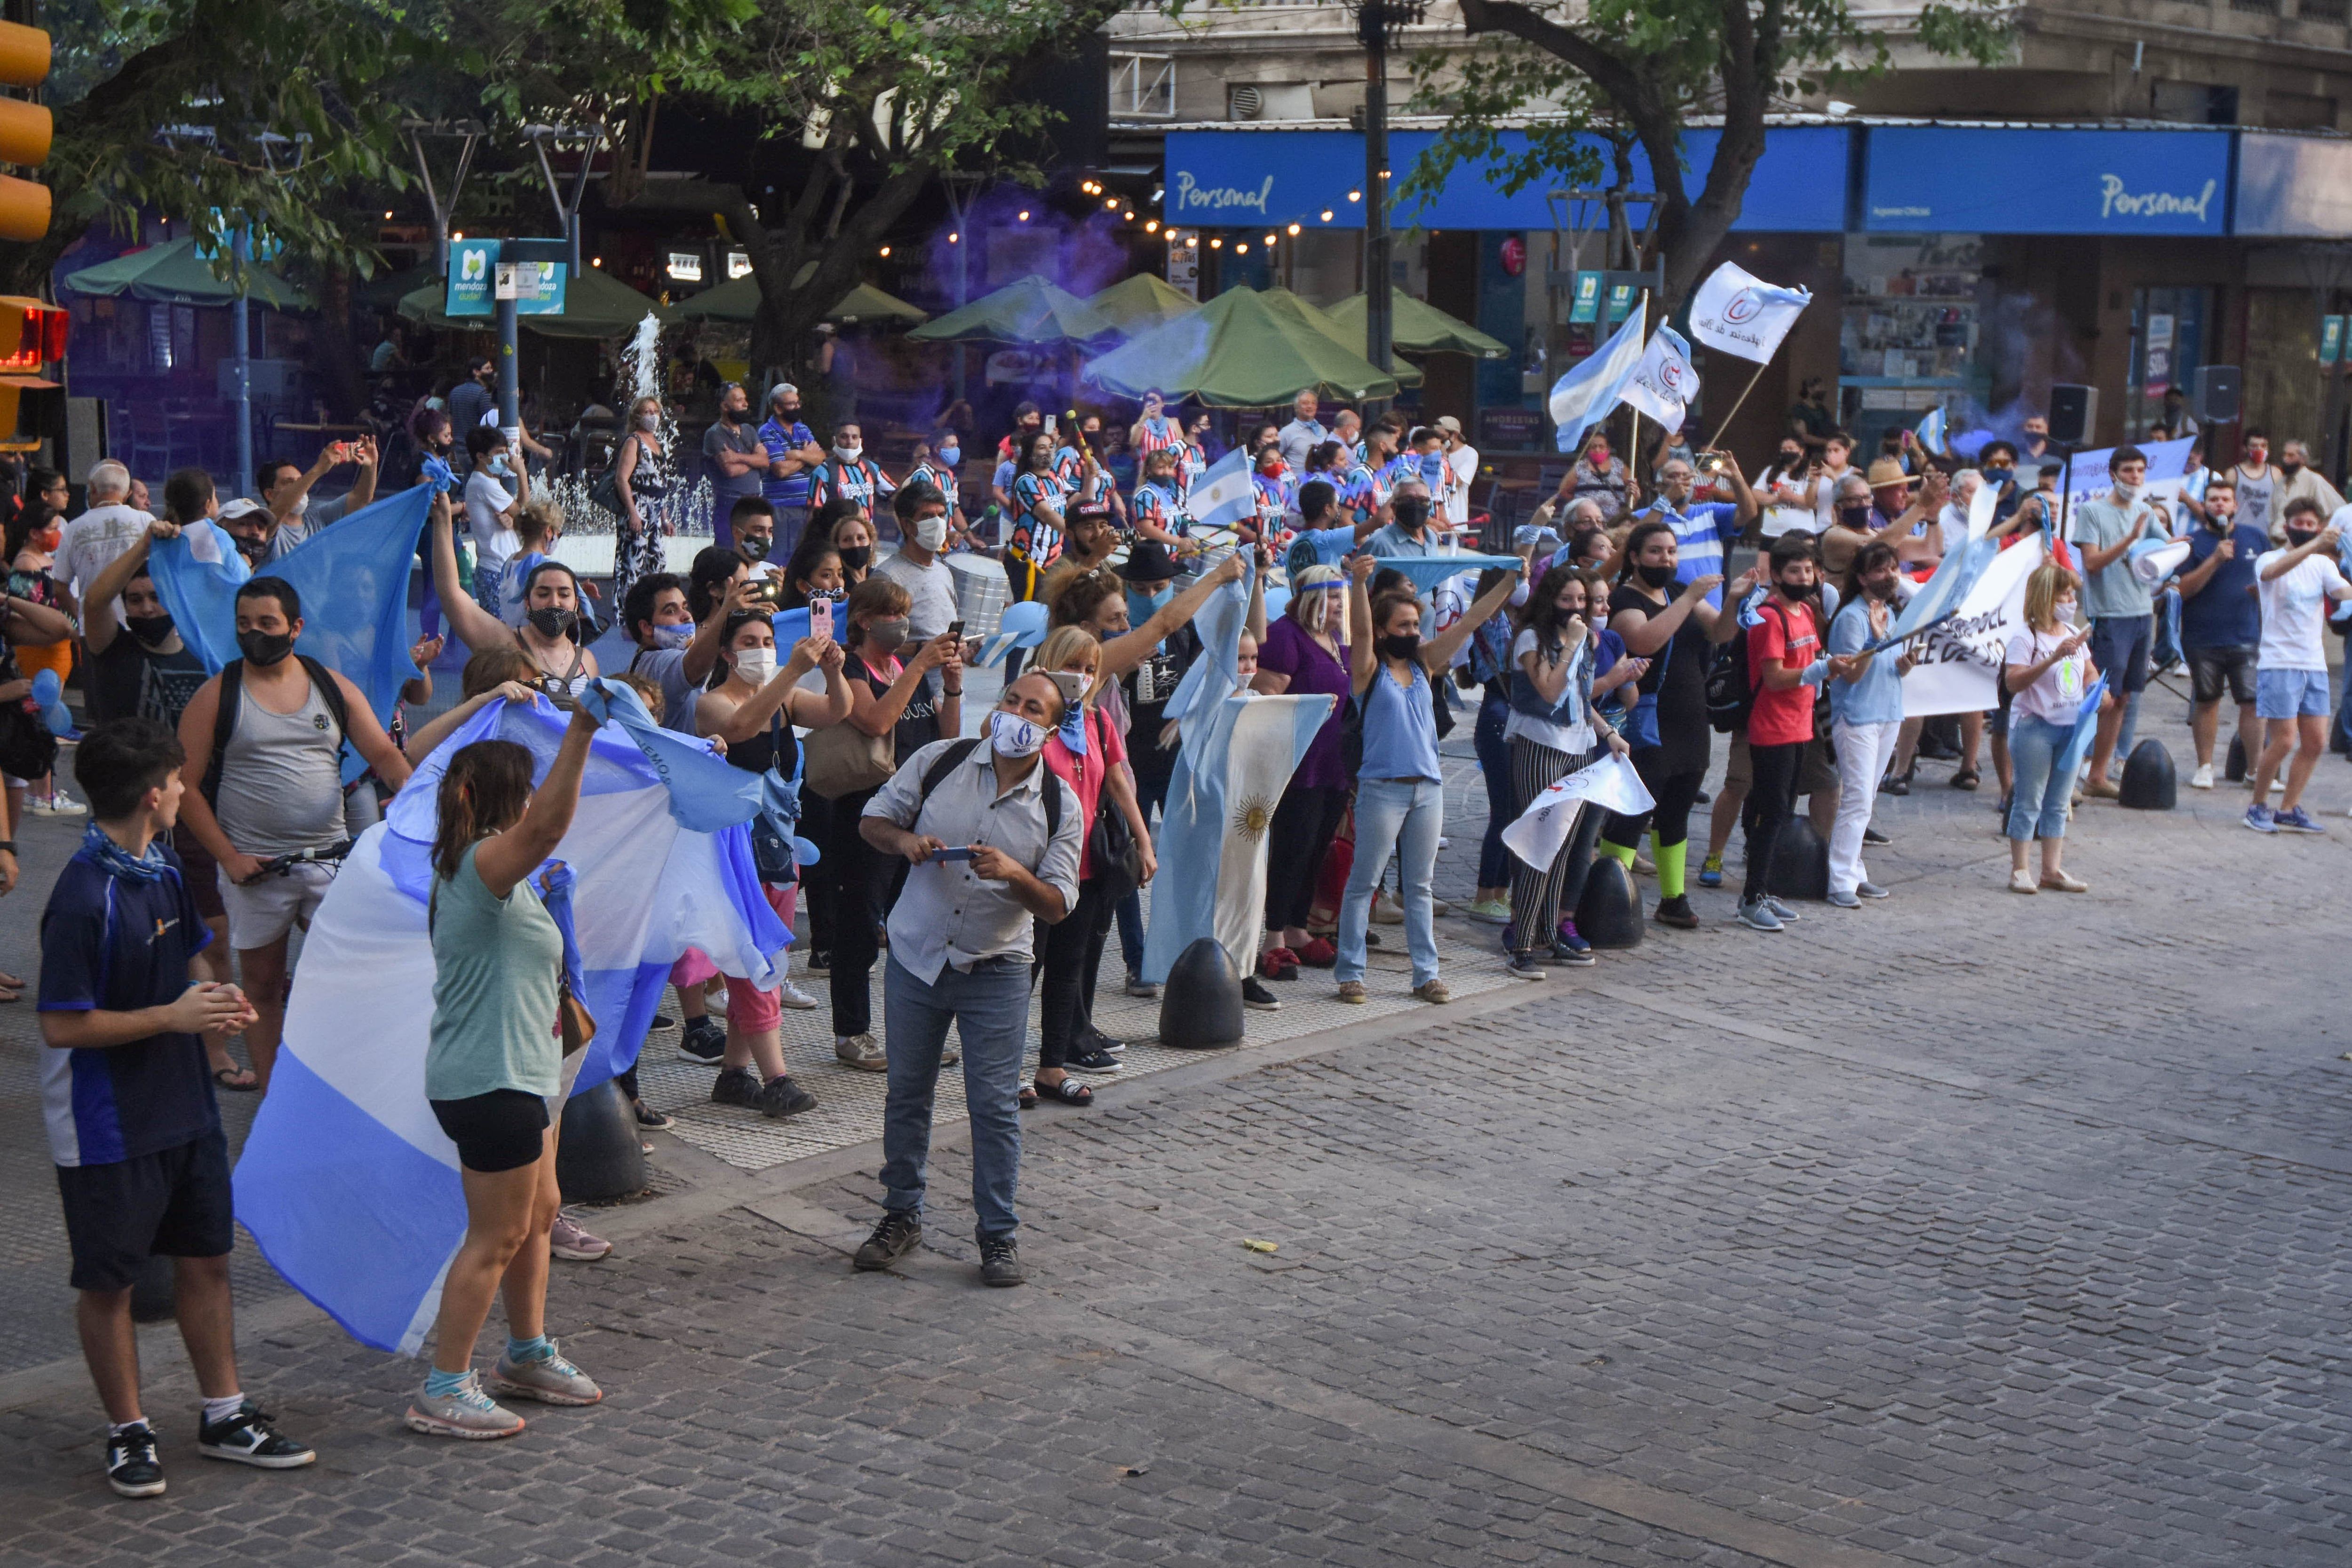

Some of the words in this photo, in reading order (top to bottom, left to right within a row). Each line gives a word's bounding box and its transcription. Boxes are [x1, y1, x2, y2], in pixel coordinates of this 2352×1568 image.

[1177, 171, 1273, 214] Personal
[2102, 173, 2217, 223] Personal
[454, 282, 487, 291] mendoza
